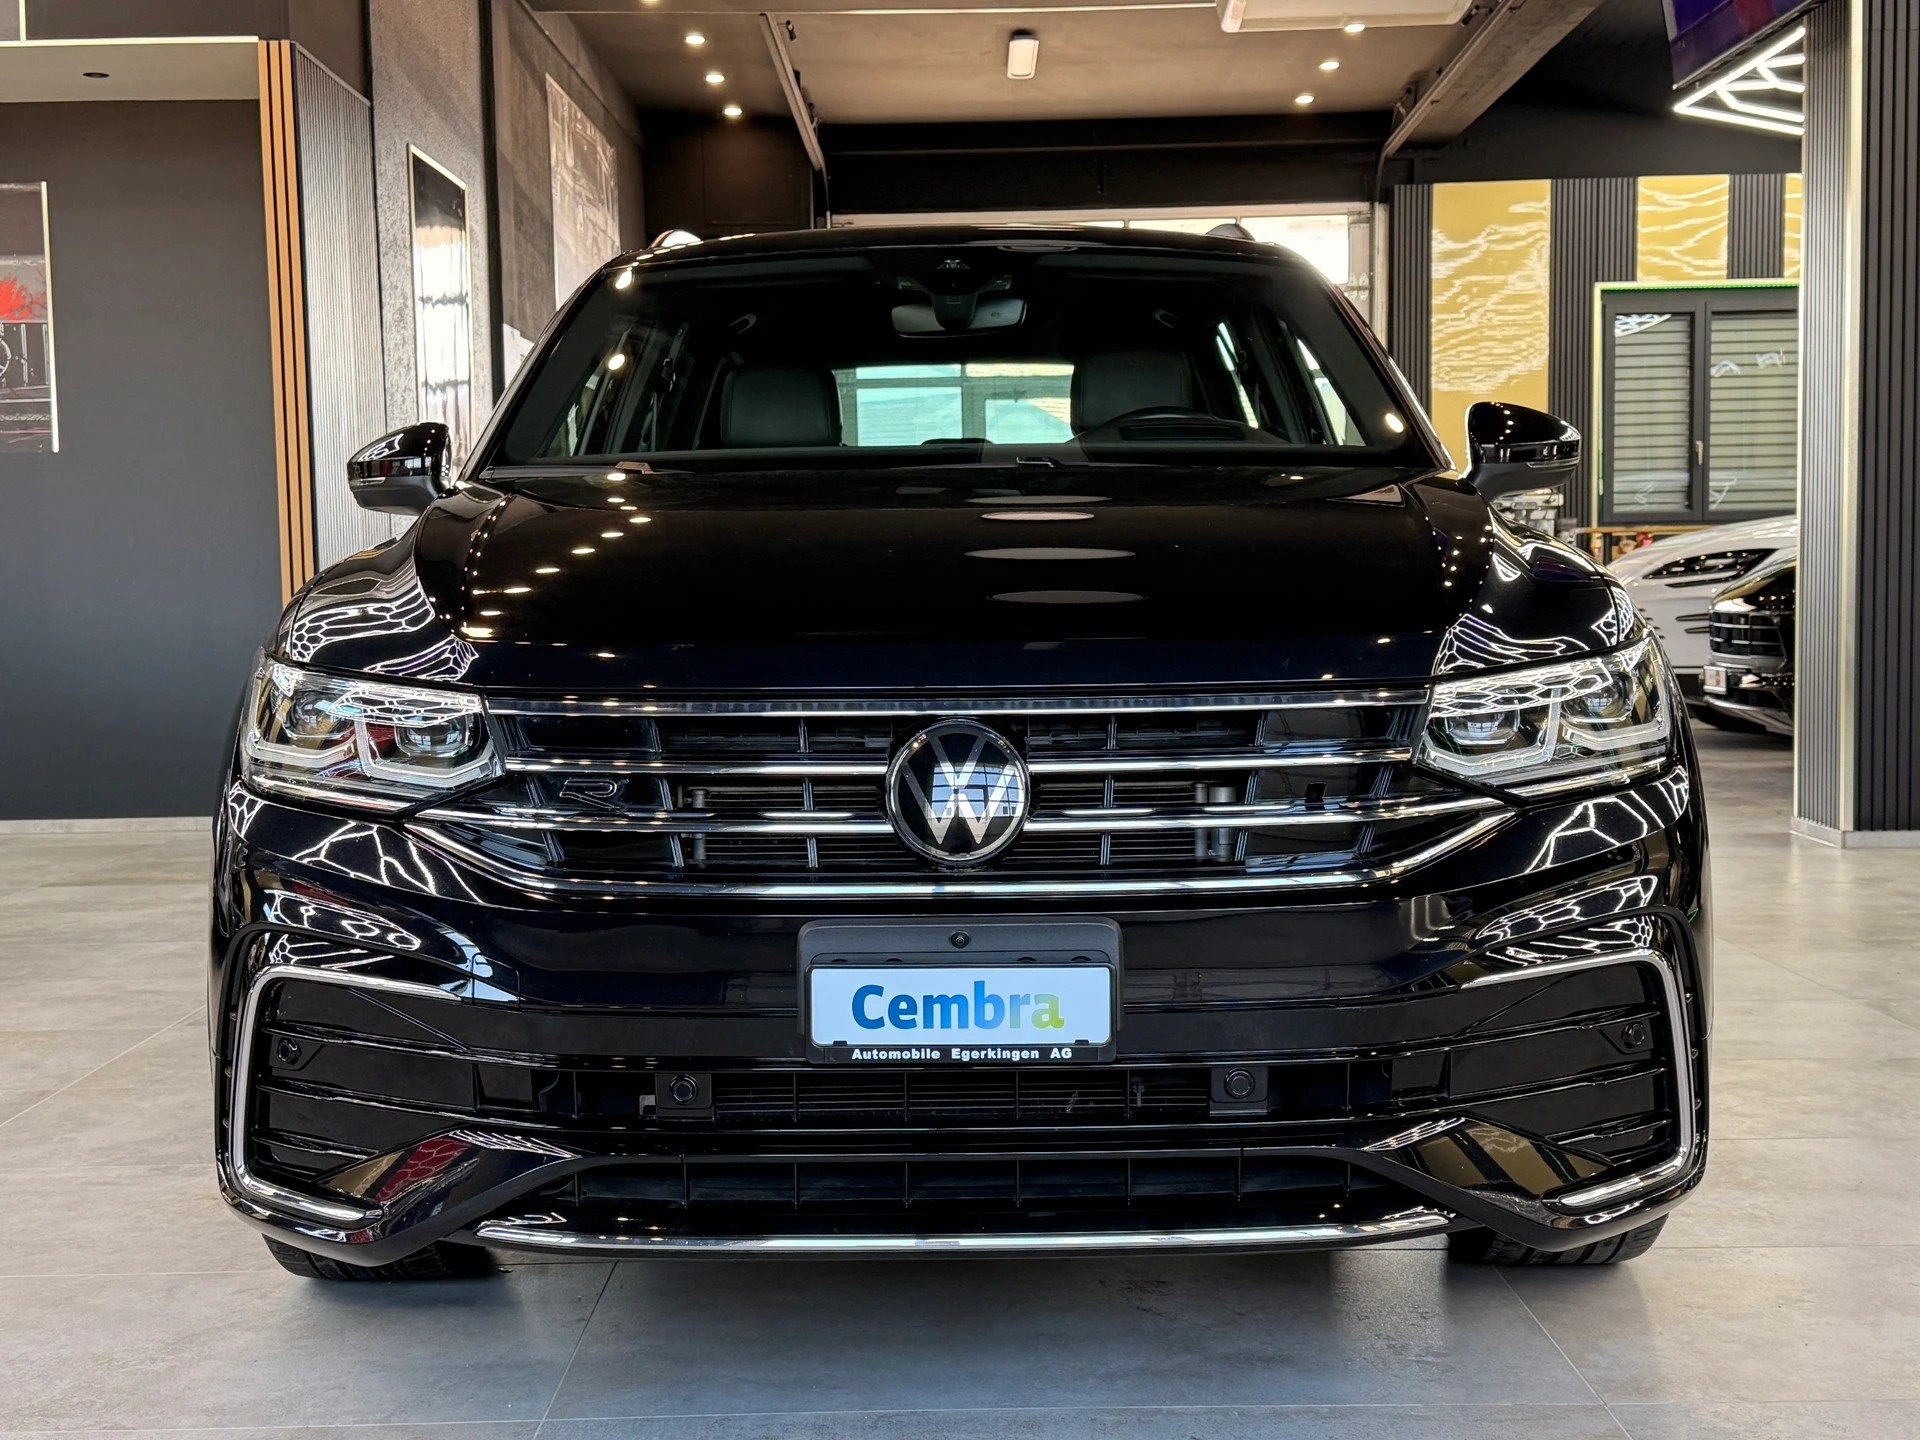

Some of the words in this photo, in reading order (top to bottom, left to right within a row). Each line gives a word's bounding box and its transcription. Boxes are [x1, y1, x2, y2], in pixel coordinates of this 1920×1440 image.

[851, 980, 1065, 1031] Cembra
[851, 1047, 941, 1060] Automobile
[951, 1047, 1040, 1062] Egerkingen
[1050, 1047, 1073, 1060] AG
